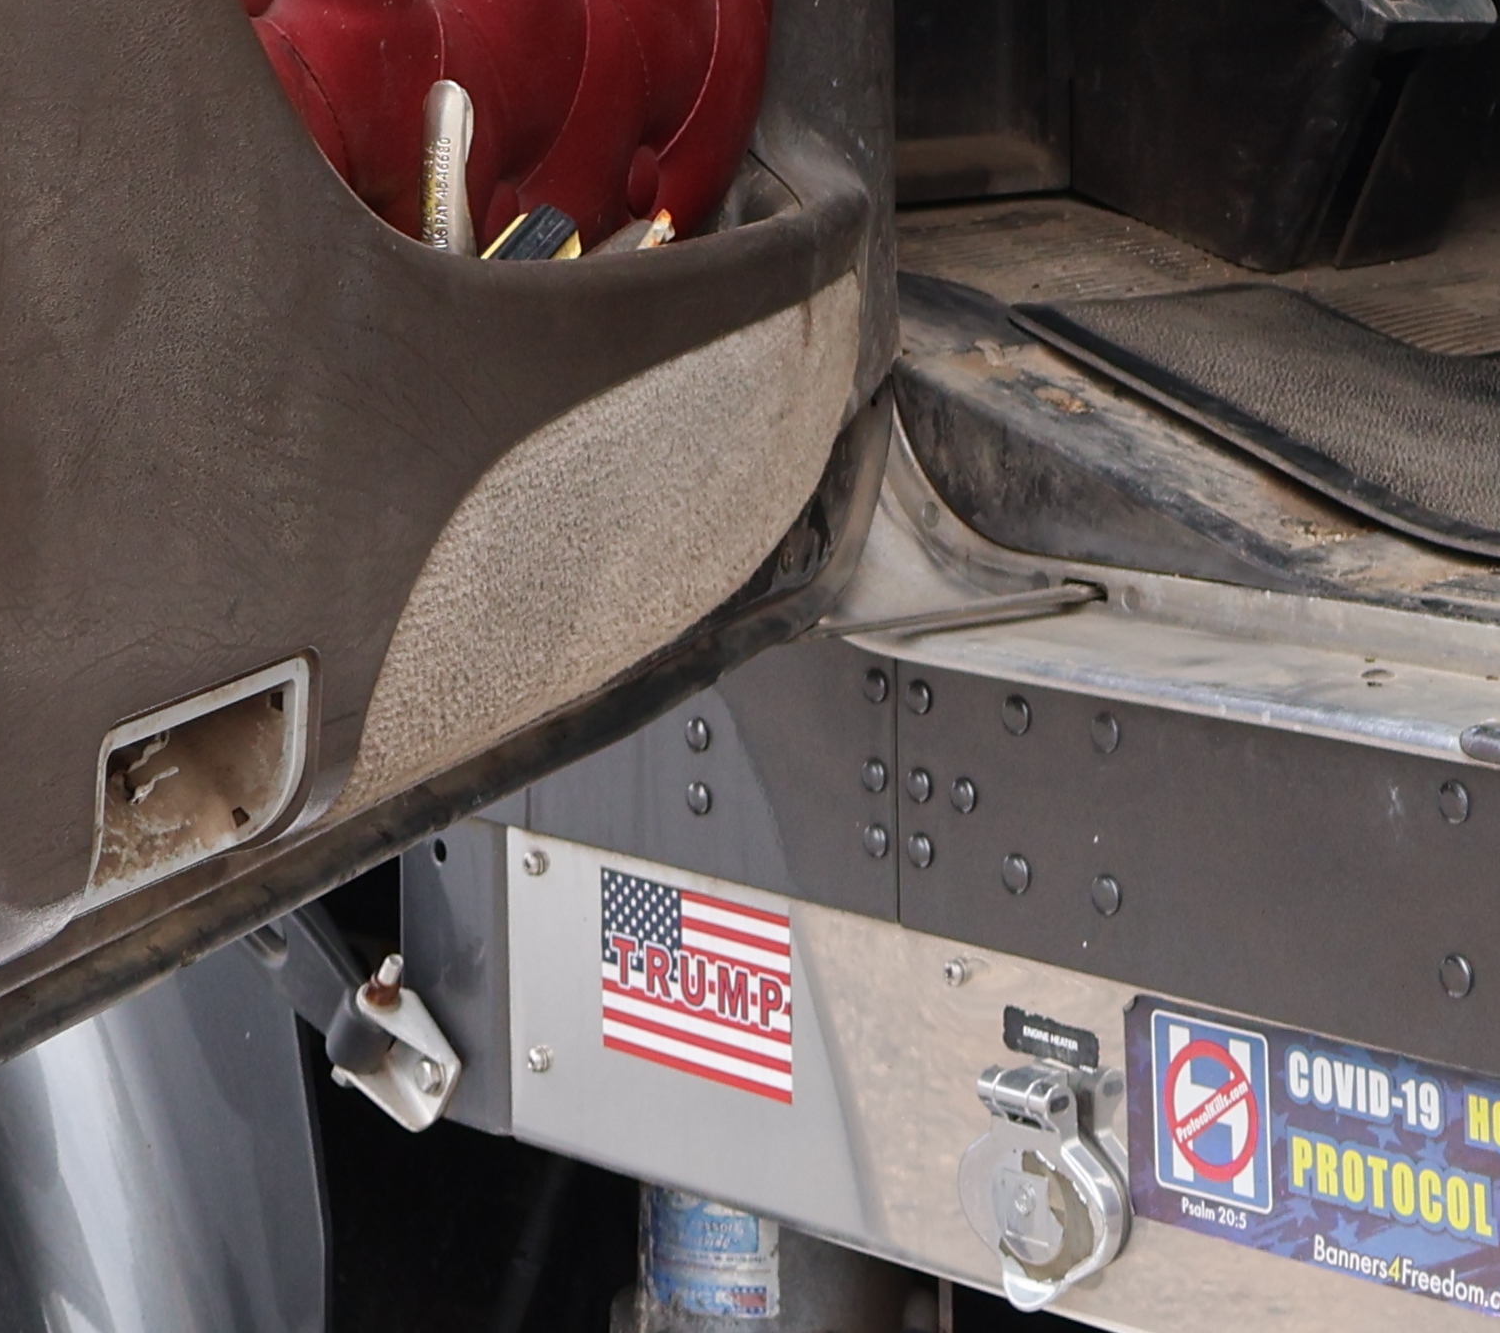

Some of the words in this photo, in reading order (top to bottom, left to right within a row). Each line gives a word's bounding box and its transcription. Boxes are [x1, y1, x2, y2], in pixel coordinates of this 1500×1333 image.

[611, 933, 784, 1029] TRUMP
[1022, 1025, 1050, 1043] ENGINE
[1050, 1032, 1079, 1052] HEATER
[1175, 1080, 1250, 1144] ProtocolKills.com
[1287, 1049, 1441, 1132] COVID-19
[1181, 1196, 1216, 1223] Psalm
[1217, 1205, 1248, 1230] 20:5
[1291, 1135, 1493, 1238] PROTOCOL
